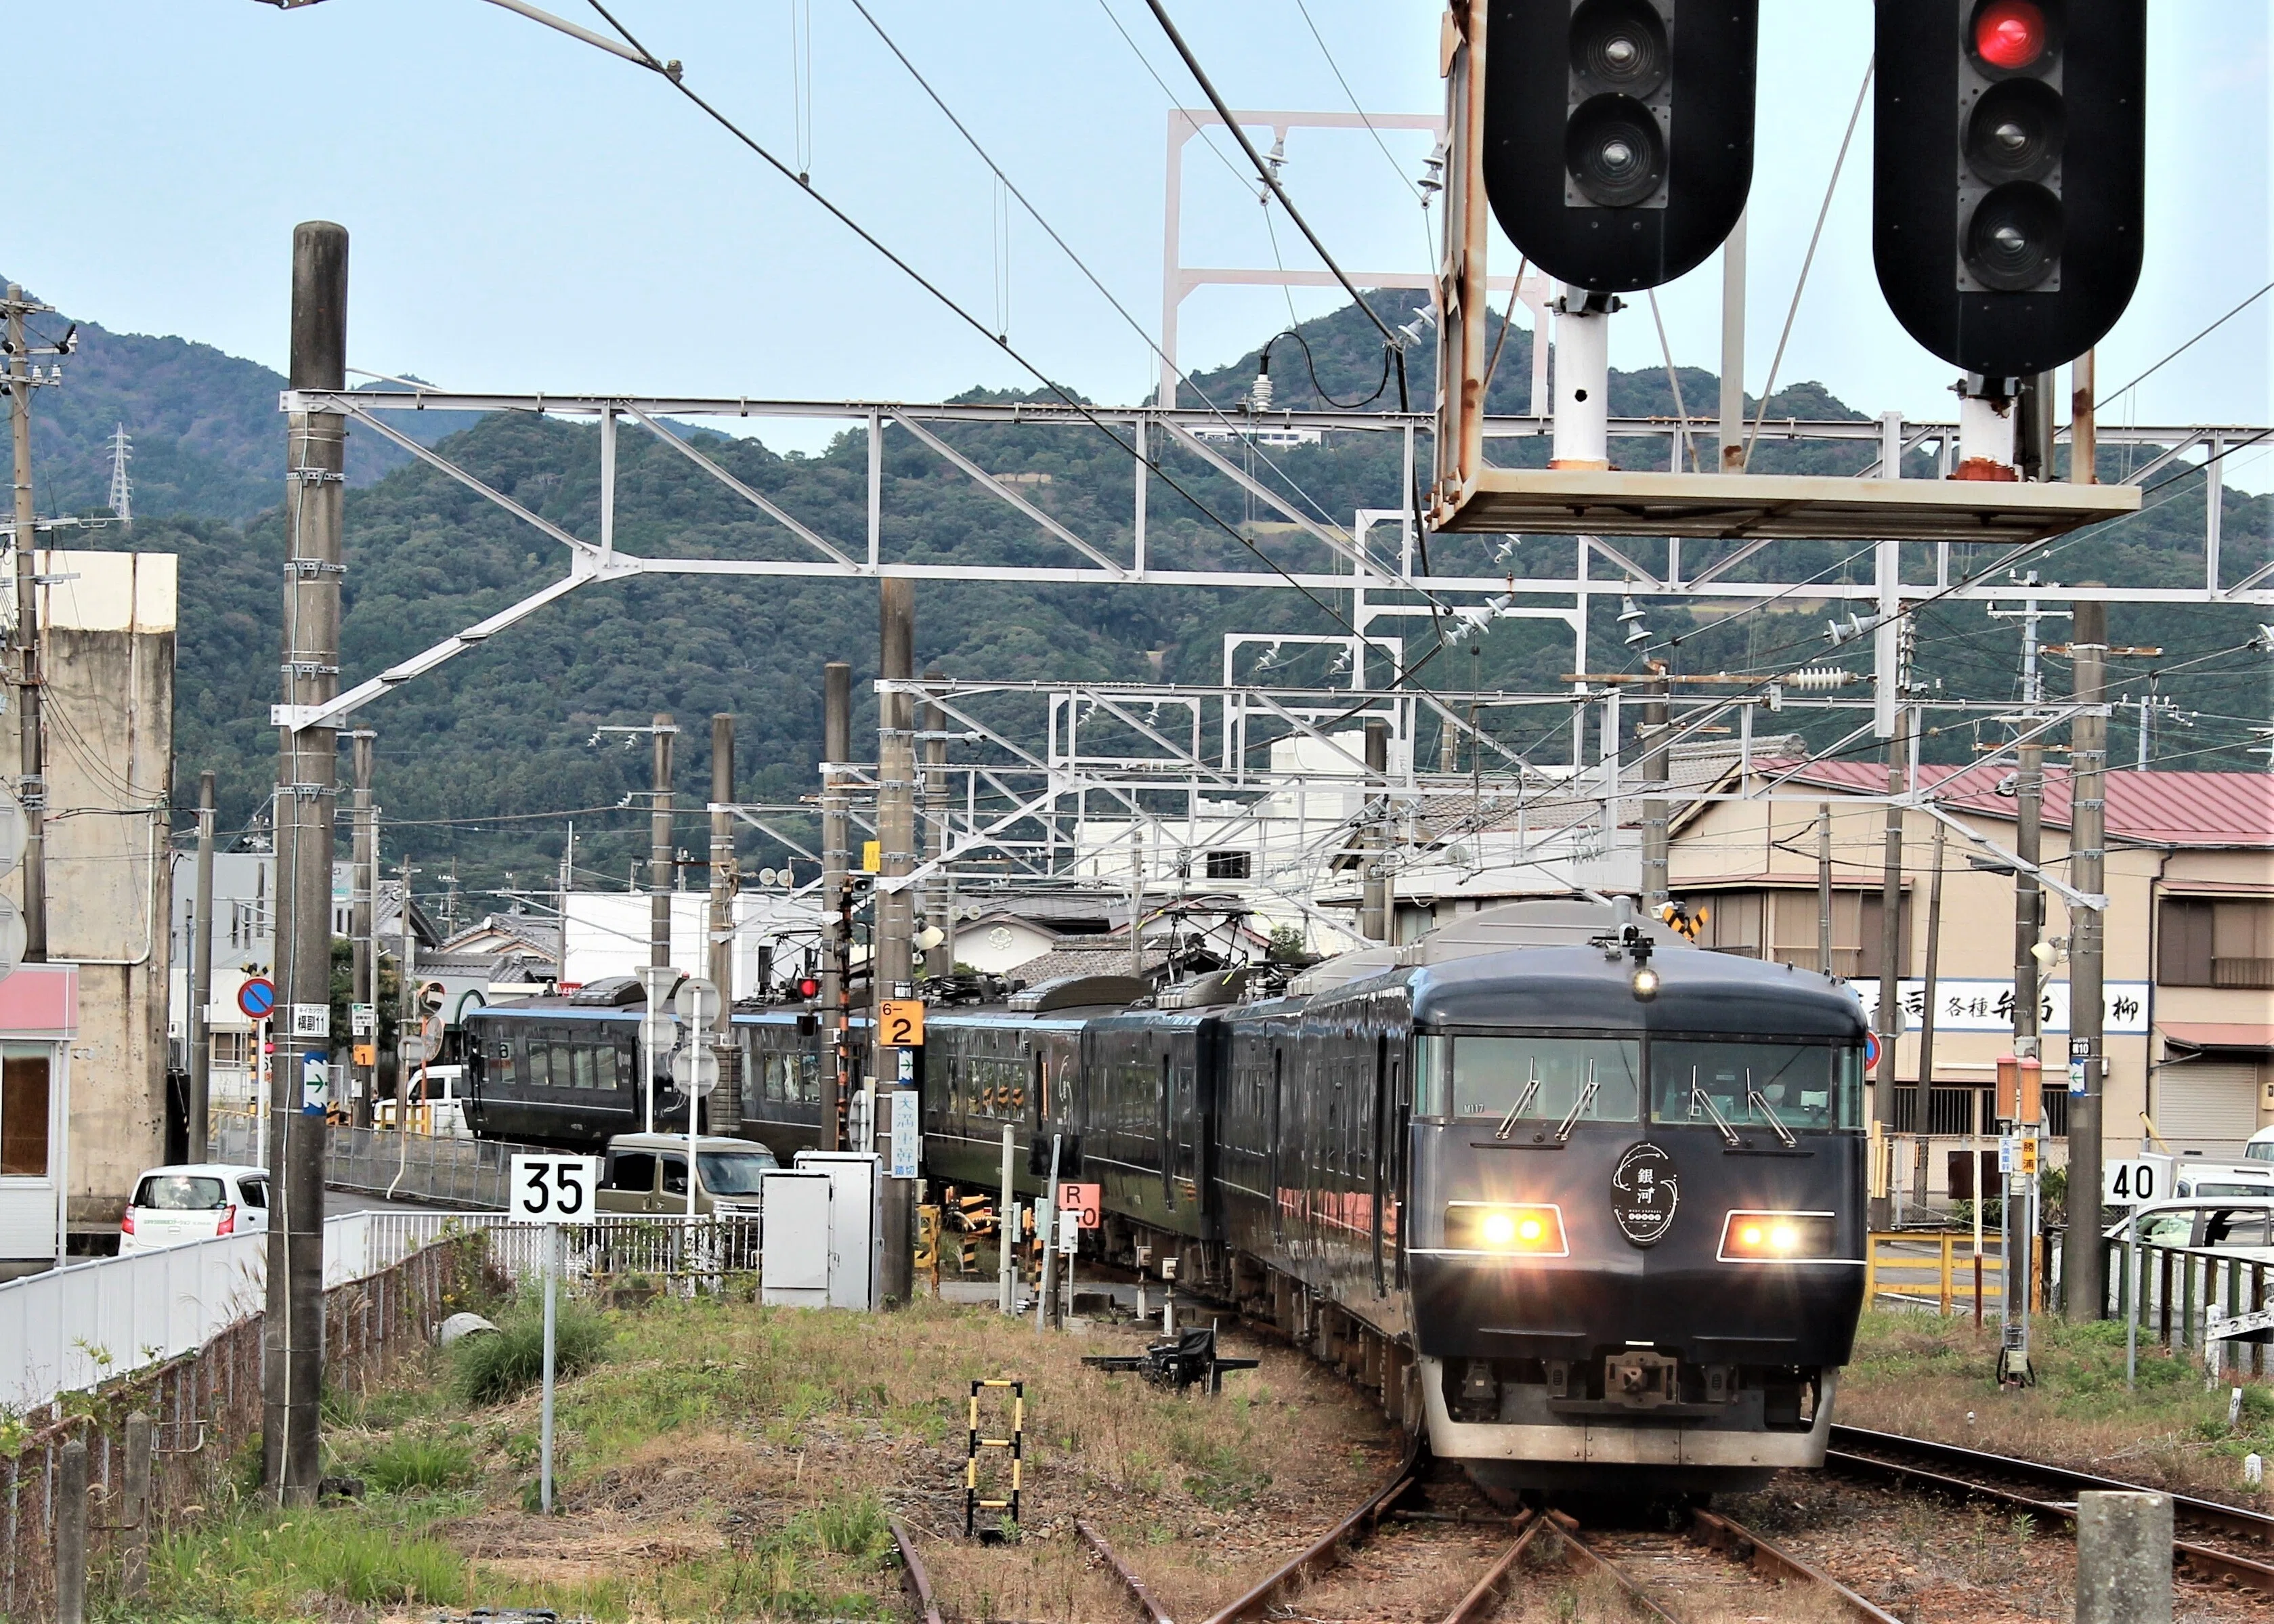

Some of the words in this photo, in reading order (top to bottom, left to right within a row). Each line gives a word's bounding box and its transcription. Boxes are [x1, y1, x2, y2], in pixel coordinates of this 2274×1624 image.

[892, 1018, 911, 1043] 2
[361, 1053, 366, 1065] 1
[1463, 1104, 1484, 1113] M117
[2023, 1141, 2034, 1170] 勝浦
[895, 1166, 915, 1175] 踏切
[2113, 1164, 2153, 1199] 40
[523, 1162, 584, 1214] 35
[1067, 1185, 1081, 1203] R
[1637, 1168, 1655, 1203] 銀河
